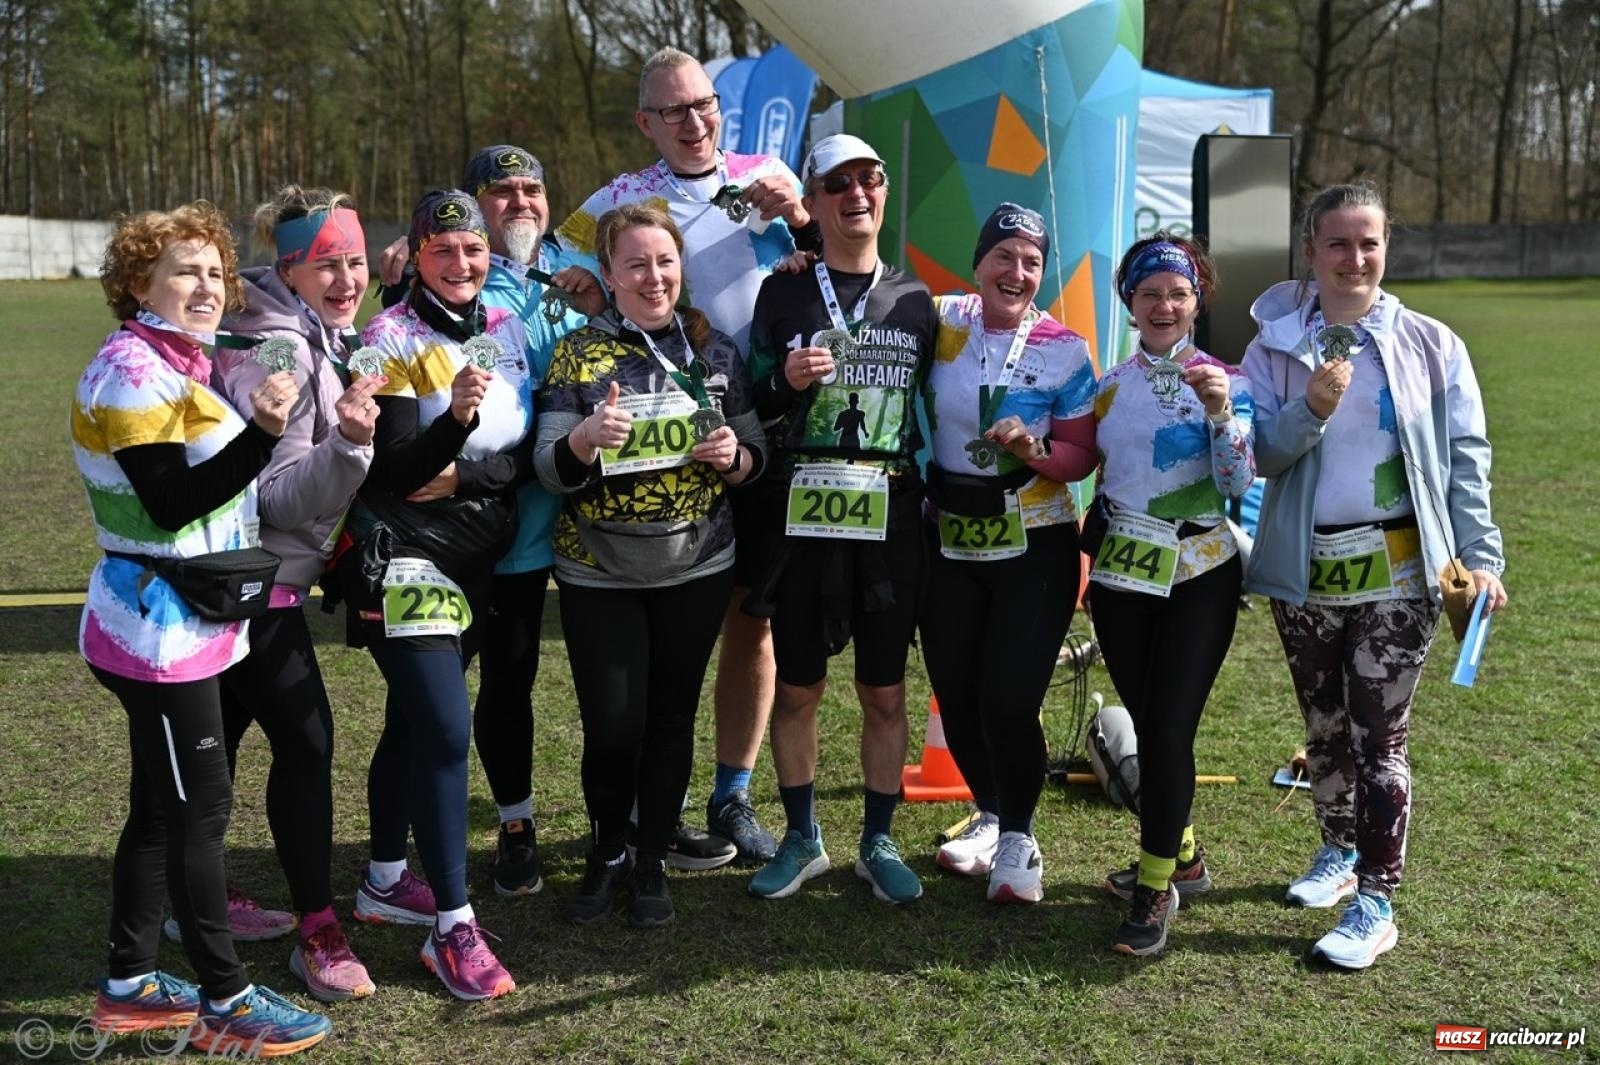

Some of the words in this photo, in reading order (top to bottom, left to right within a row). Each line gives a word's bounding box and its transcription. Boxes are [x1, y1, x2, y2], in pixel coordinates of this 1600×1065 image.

[1160, 253, 1190, 267] HERO
[853, 325, 917, 351] UŹNIAŃSKI
[617, 419, 687, 459] 240
[801, 489, 872, 525] 204
[948, 516, 1012, 548] 232
[1100, 536, 1162, 580] 244
[1309, 555, 1373, 592] 247
[400, 587, 462, 622] 225
